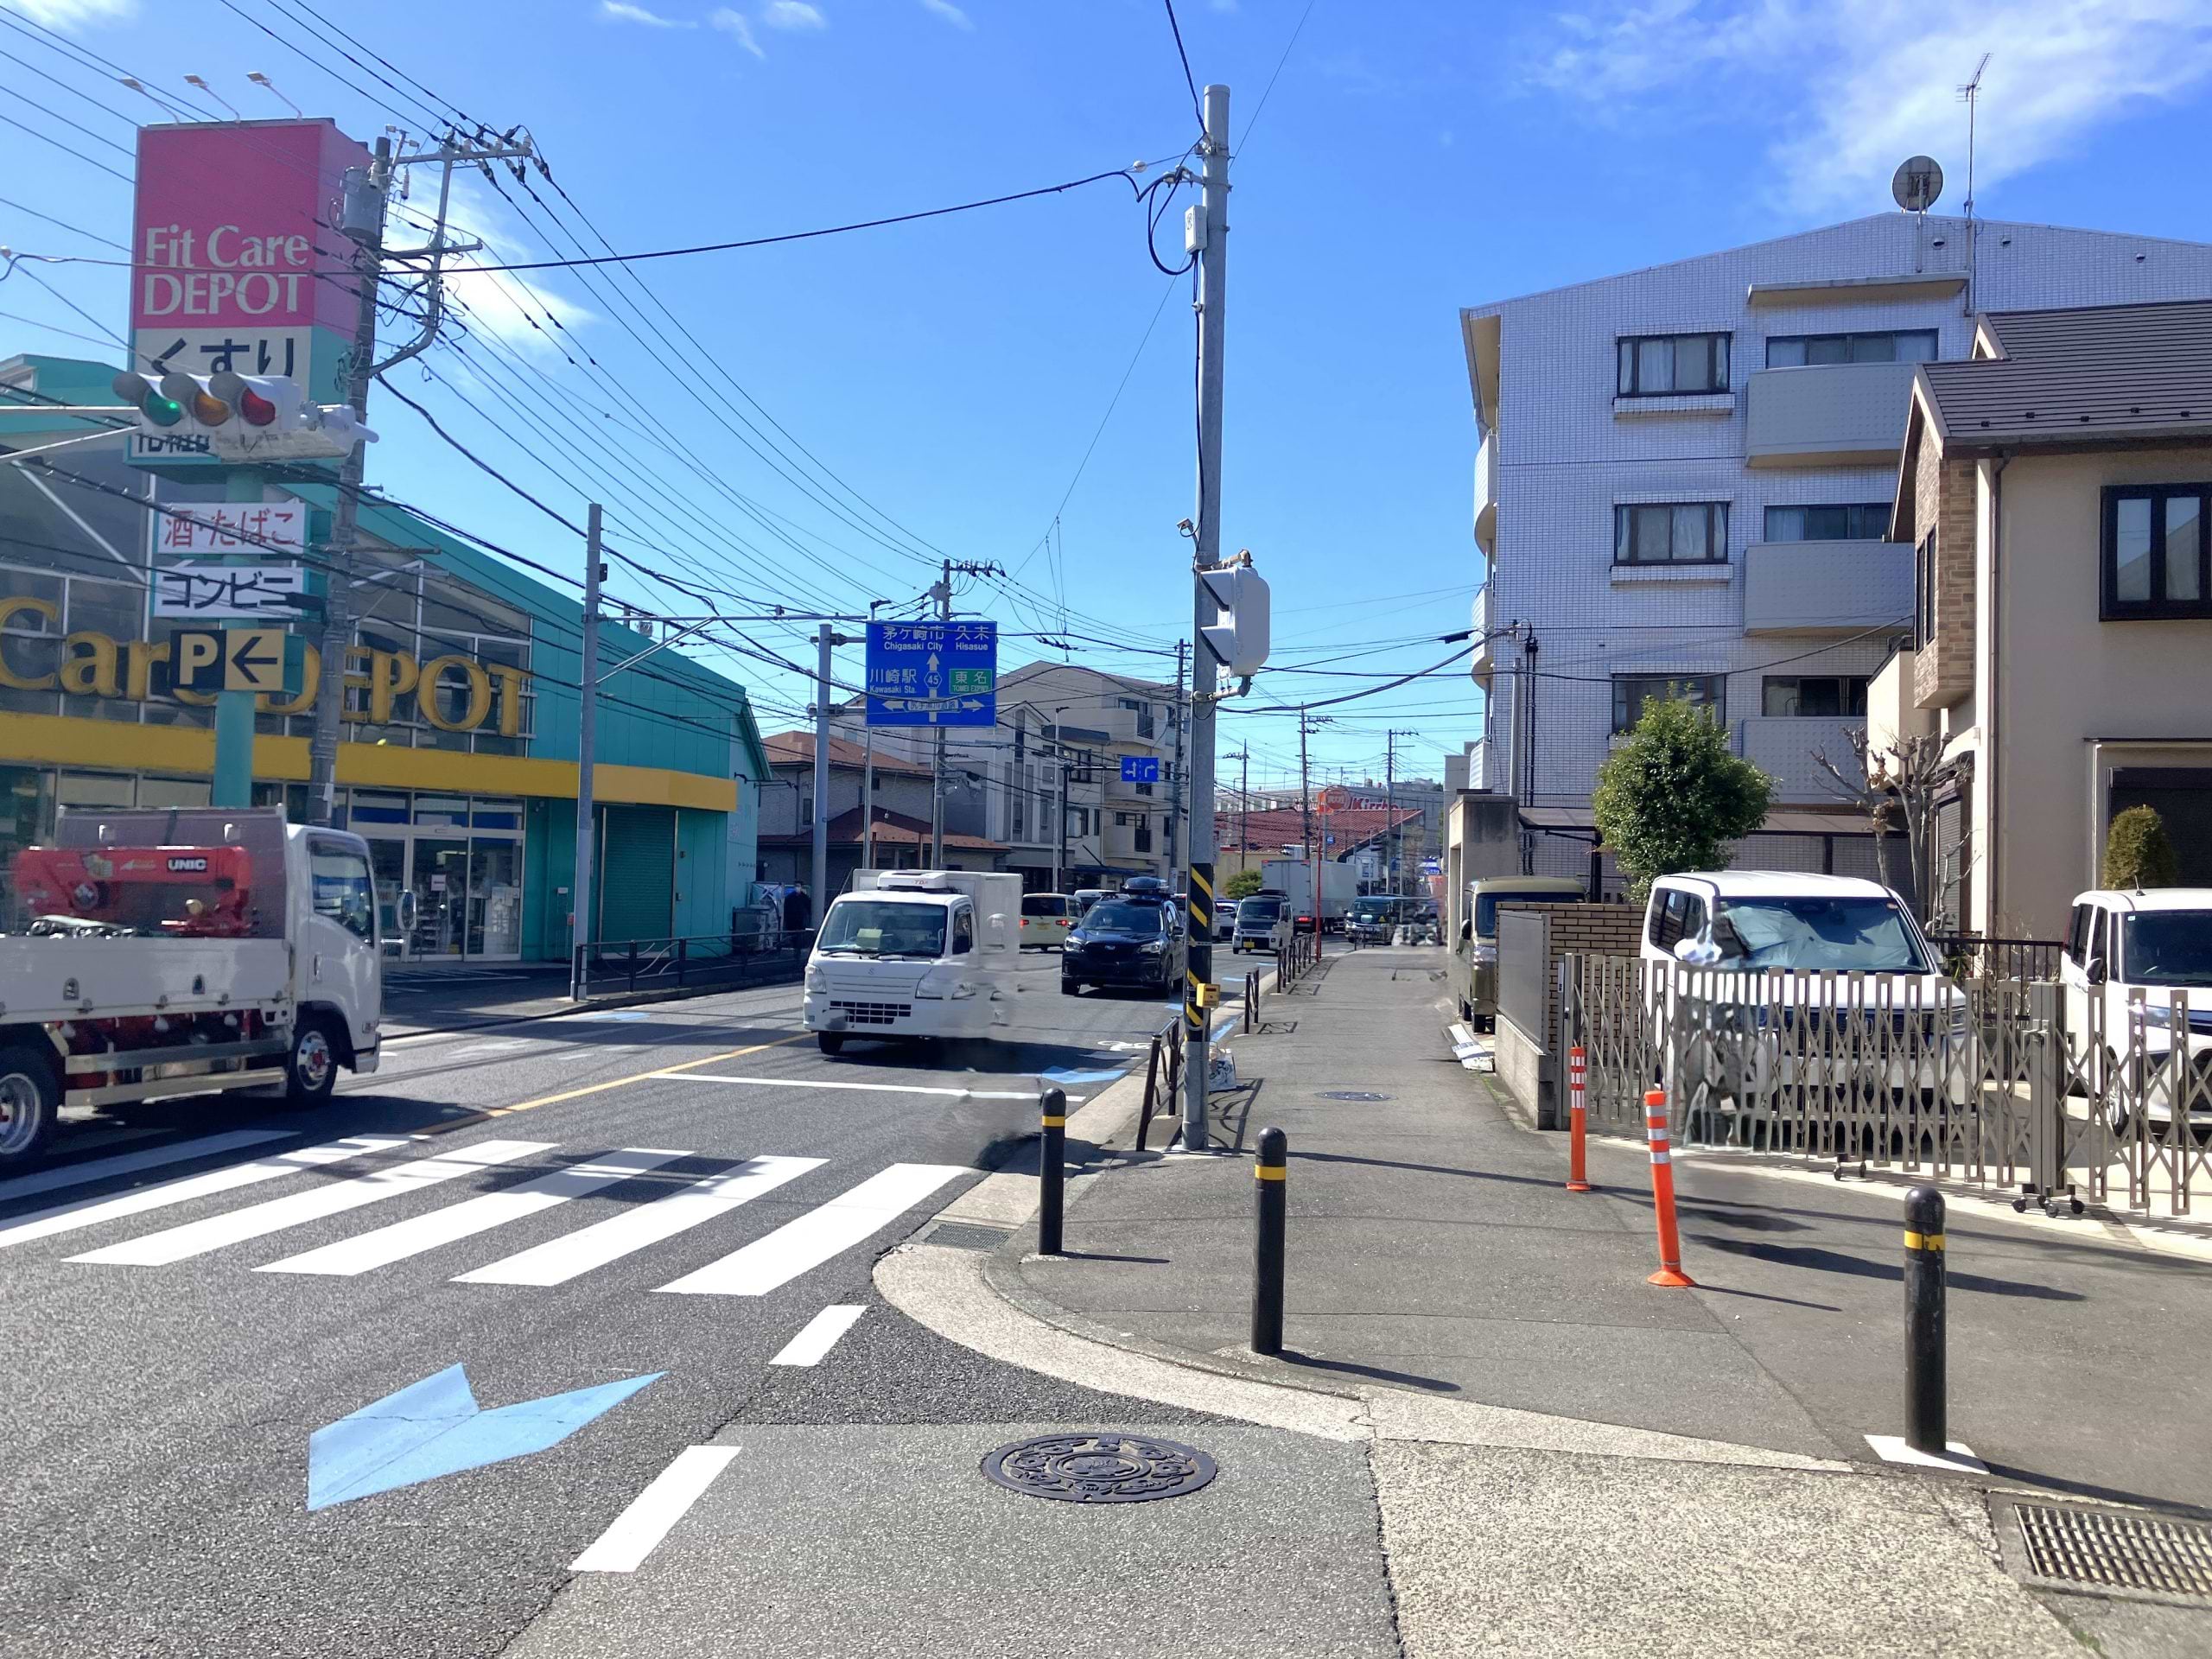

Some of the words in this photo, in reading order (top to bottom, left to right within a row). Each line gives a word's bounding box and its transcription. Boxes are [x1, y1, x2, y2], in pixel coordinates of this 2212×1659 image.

[144, 224, 195, 269] Fit
[207, 225, 309, 268] Care
[143, 272, 308, 315] DEPOT
[150, 338, 294, 378] くすり
[162, 570, 294, 610] コンビニ
[955, 625, 989, 640] 久末
[884, 641, 924, 652] Chigasaki
[927, 641, 943, 652] City
[956, 642, 988, 651] Hisasue
[179, 632, 219, 685] P
[869, 668, 917, 683] 川崎駅
[927, 675, 939, 685] 45
[955, 671, 987, 684] 東名
[869, 684, 901, 694] Kawasaki
[167, 858, 207, 871] UNIC
